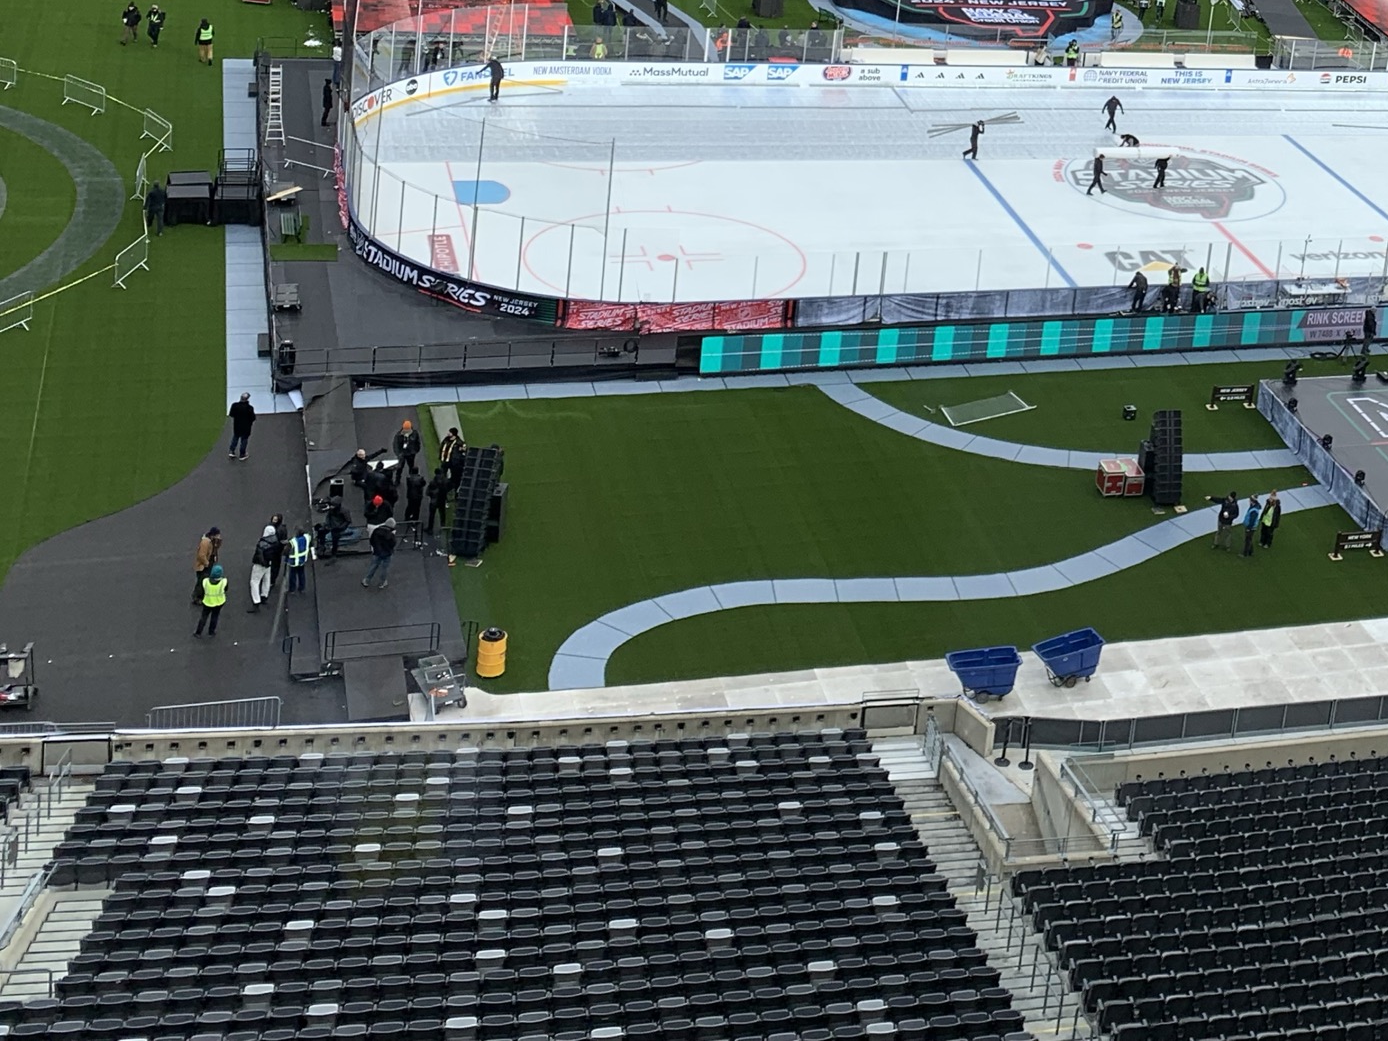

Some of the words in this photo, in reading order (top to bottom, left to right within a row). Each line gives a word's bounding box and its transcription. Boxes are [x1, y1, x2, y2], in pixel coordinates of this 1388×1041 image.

[1002, 0, 1067, 9] JERSEY
[1006, 17, 1040, 25] Union
[460, 66, 515, 82] FANDEL
[533, 66, 547, 75] NEW
[548, 66, 590, 75] AMSTERDAM
[592, 66, 612, 76] VODKA
[643, 67, 709, 77] MassMutual
[724, 67, 749, 79] SAP
[767, 67, 792, 79] SAP
[1335, 75, 1367, 84] PEPSI
[352, 88, 393, 120] DISCOVER
[1076, 168, 1263, 186] STADIUM
[1104, 249, 1196, 272] CAT
[1289, 251, 1388, 262] verizon
[363, 241, 419, 286] STADIUM
[493, 295, 510, 303] NEW
[510, 297, 539, 308] JERSEY
[499, 303, 530, 317] 2024
[578, 309, 625, 320] STADIUM
[579, 317, 623, 328] SERIES
[1307, 312, 1329, 325] RINK
